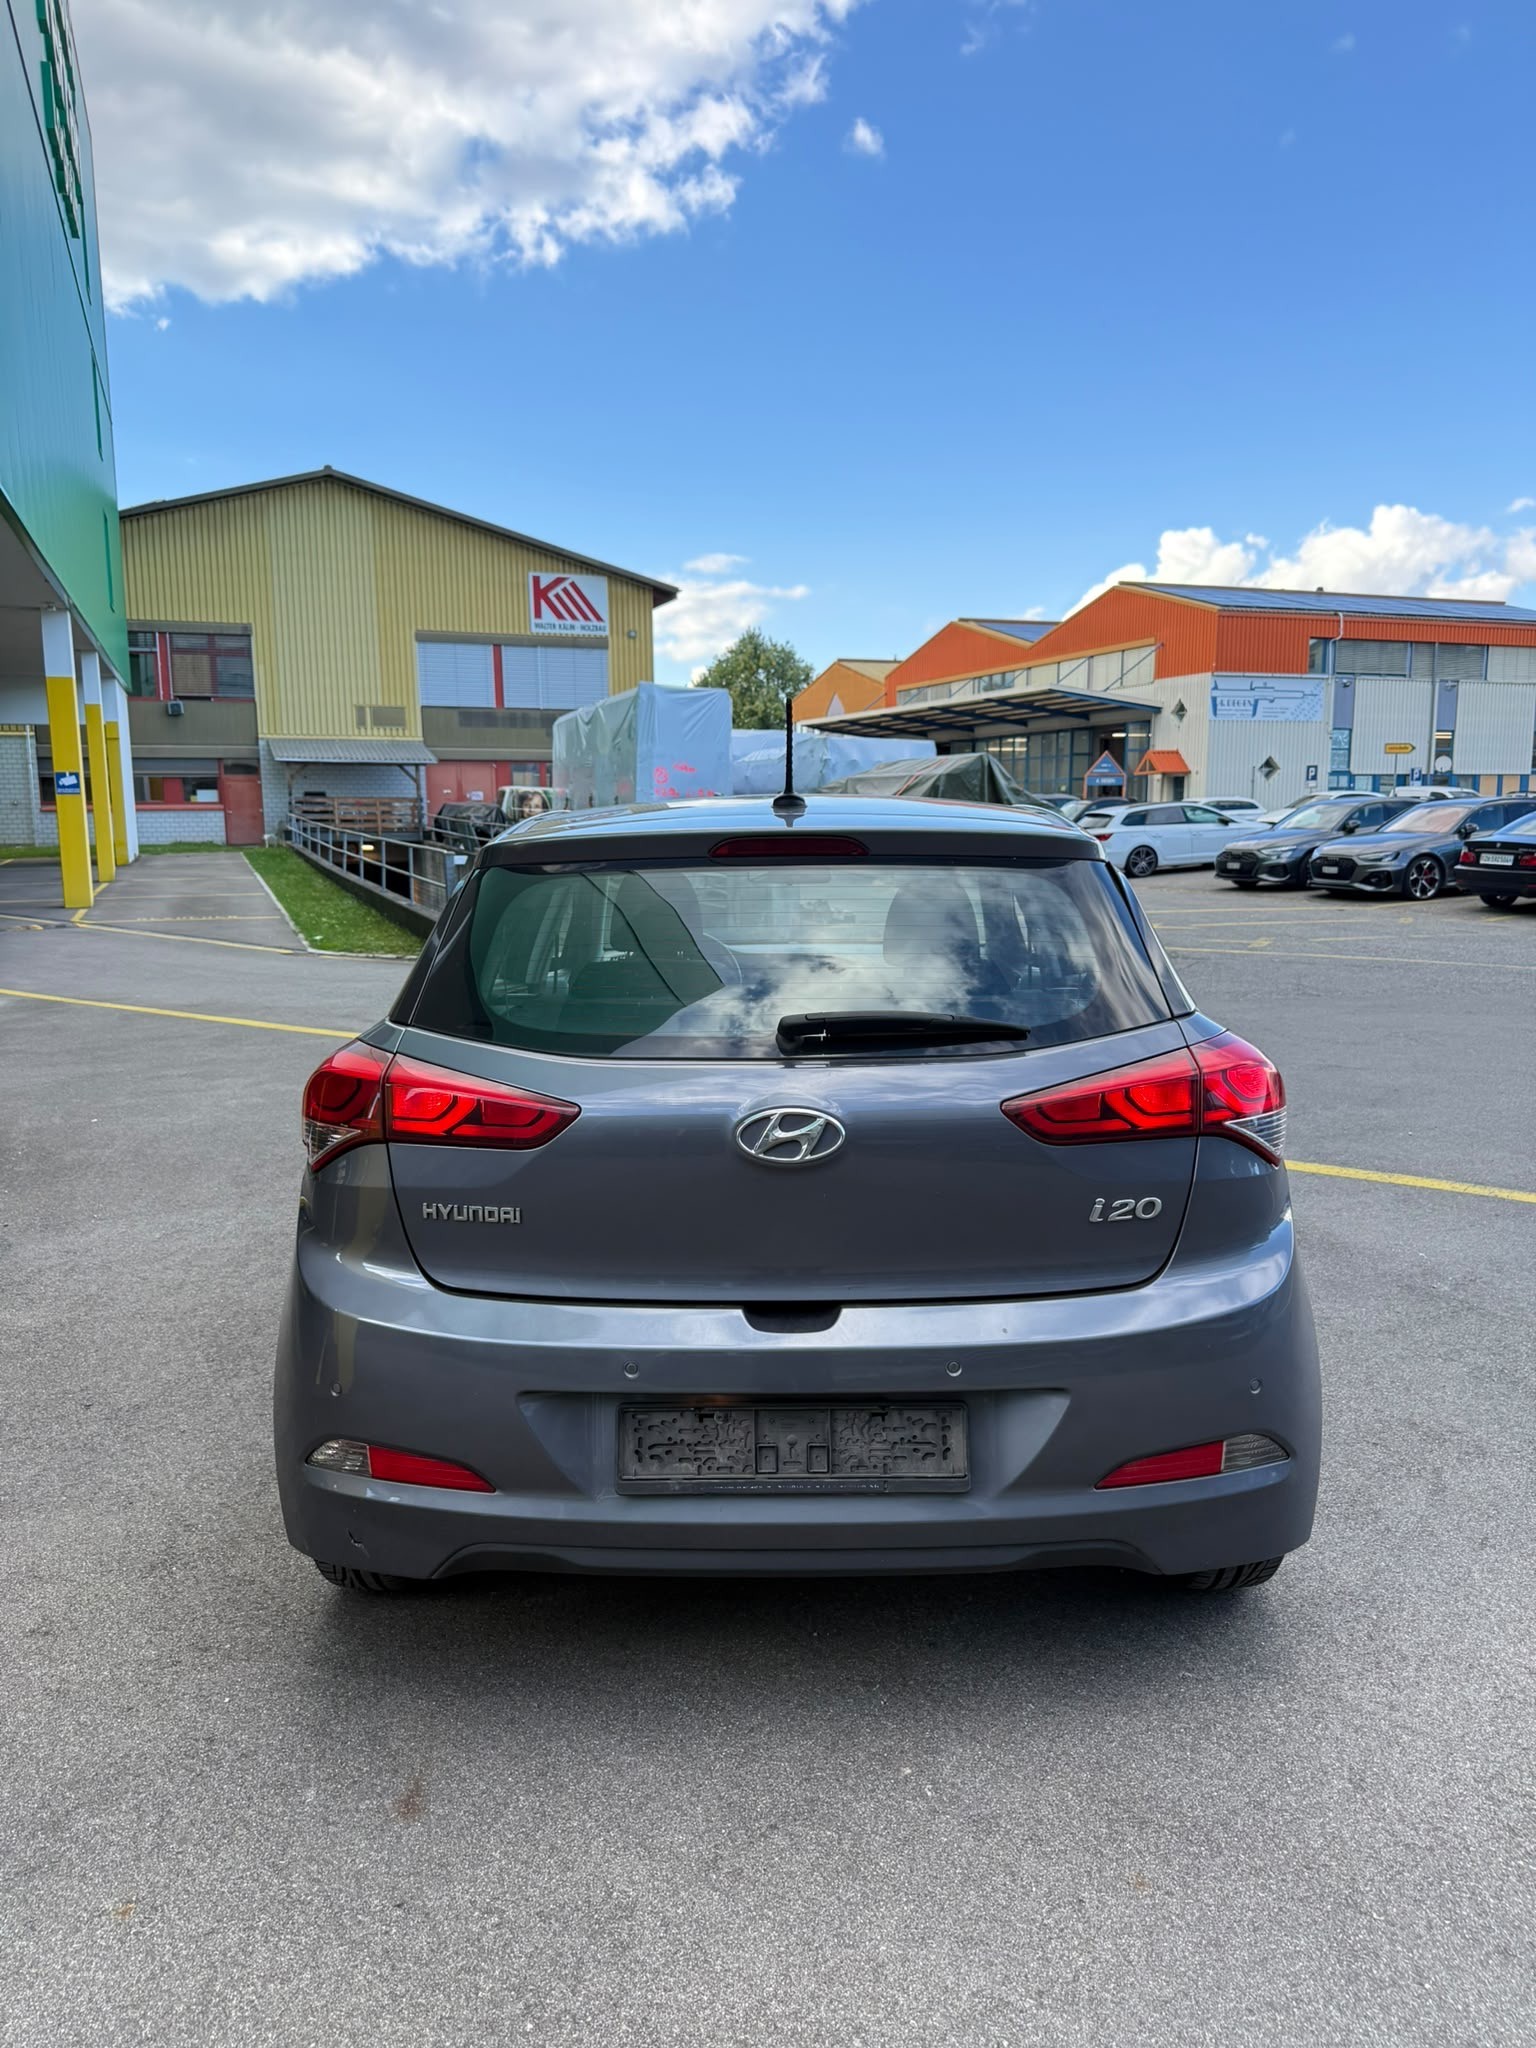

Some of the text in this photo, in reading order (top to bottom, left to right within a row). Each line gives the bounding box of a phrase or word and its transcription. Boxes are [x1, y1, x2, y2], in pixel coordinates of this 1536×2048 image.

[535, 622, 556, 630] WALTER
[580, 624, 607, 632] HOLZBAU
[1309, 768, 1315, 779] P
[422, 1202, 520, 1223] HYUNDAI
[1089, 1197, 1162, 1222] i20
